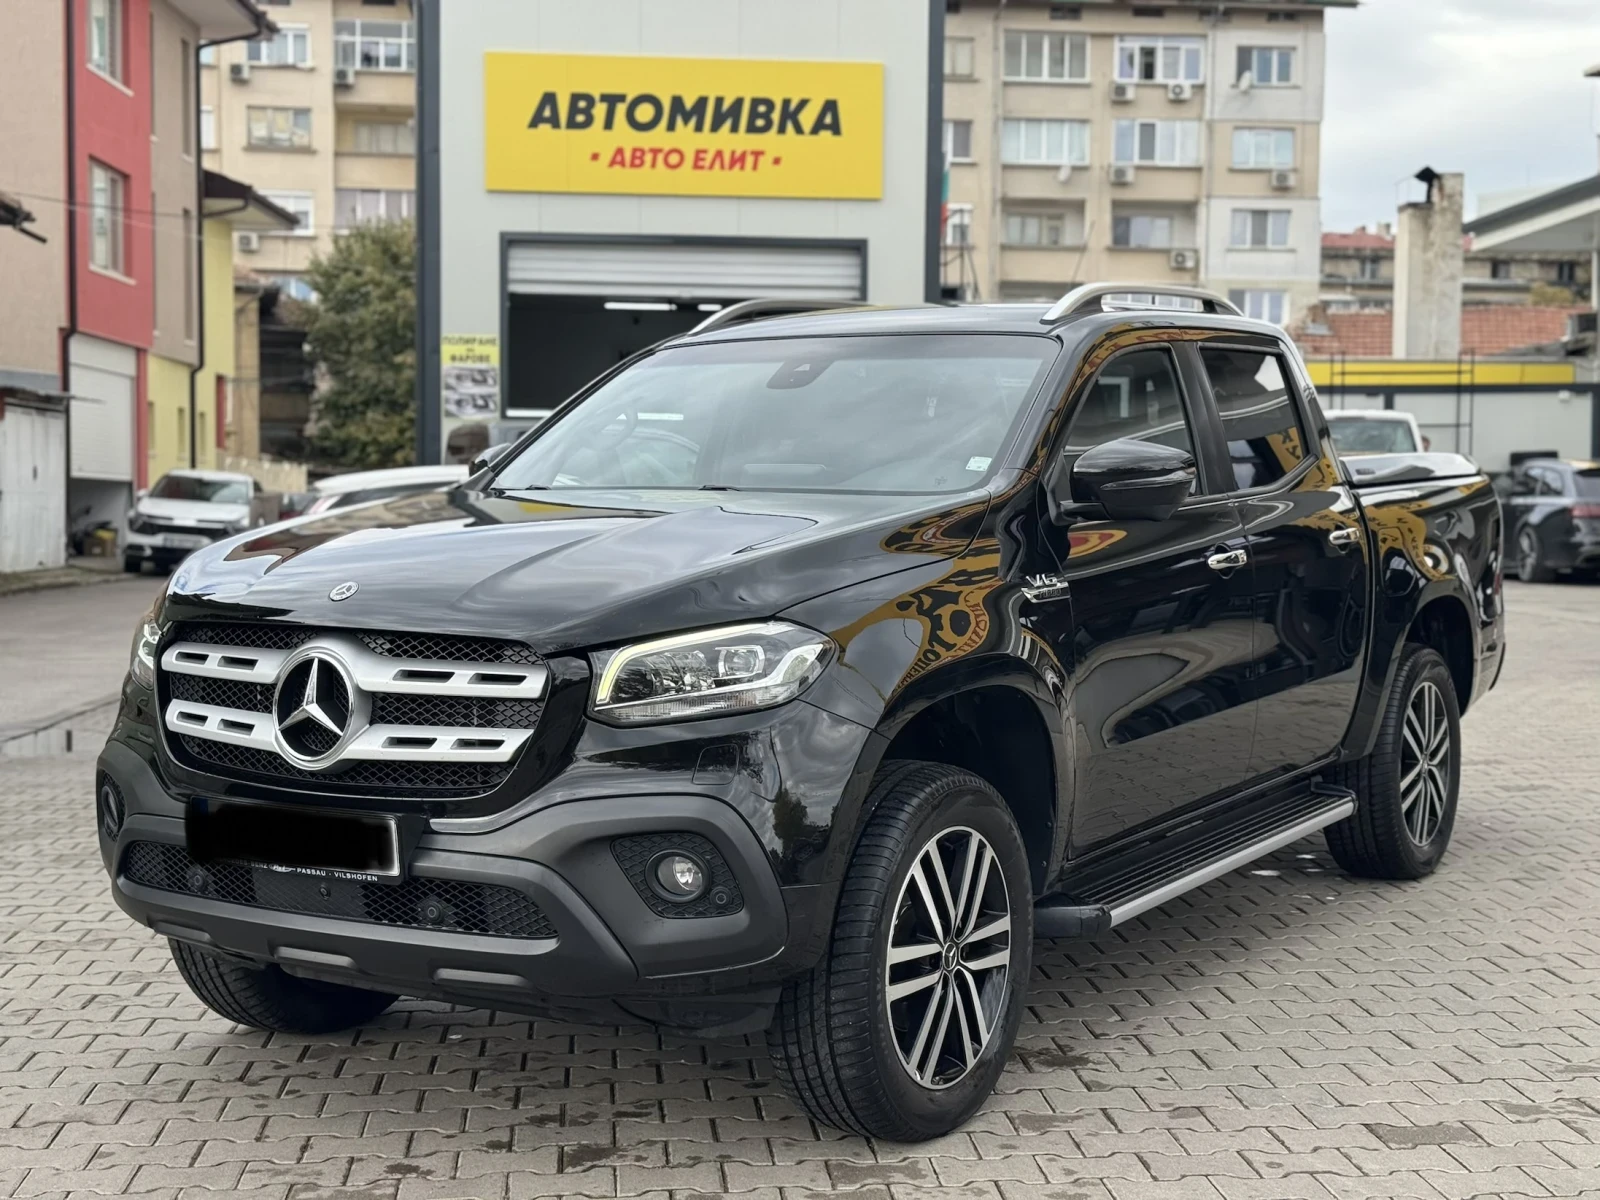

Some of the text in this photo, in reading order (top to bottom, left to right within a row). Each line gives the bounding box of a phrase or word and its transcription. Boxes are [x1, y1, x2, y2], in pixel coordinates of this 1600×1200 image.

[527, 91, 842, 136] АВТОМИВКА
[607, 146, 766, 172] АВТО ЕЛИТ
[1025, 573, 1058, 588] V6
[297, 867, 326, 877] PASSAU
[333, 872, 378, 882] VILSHOFEN
